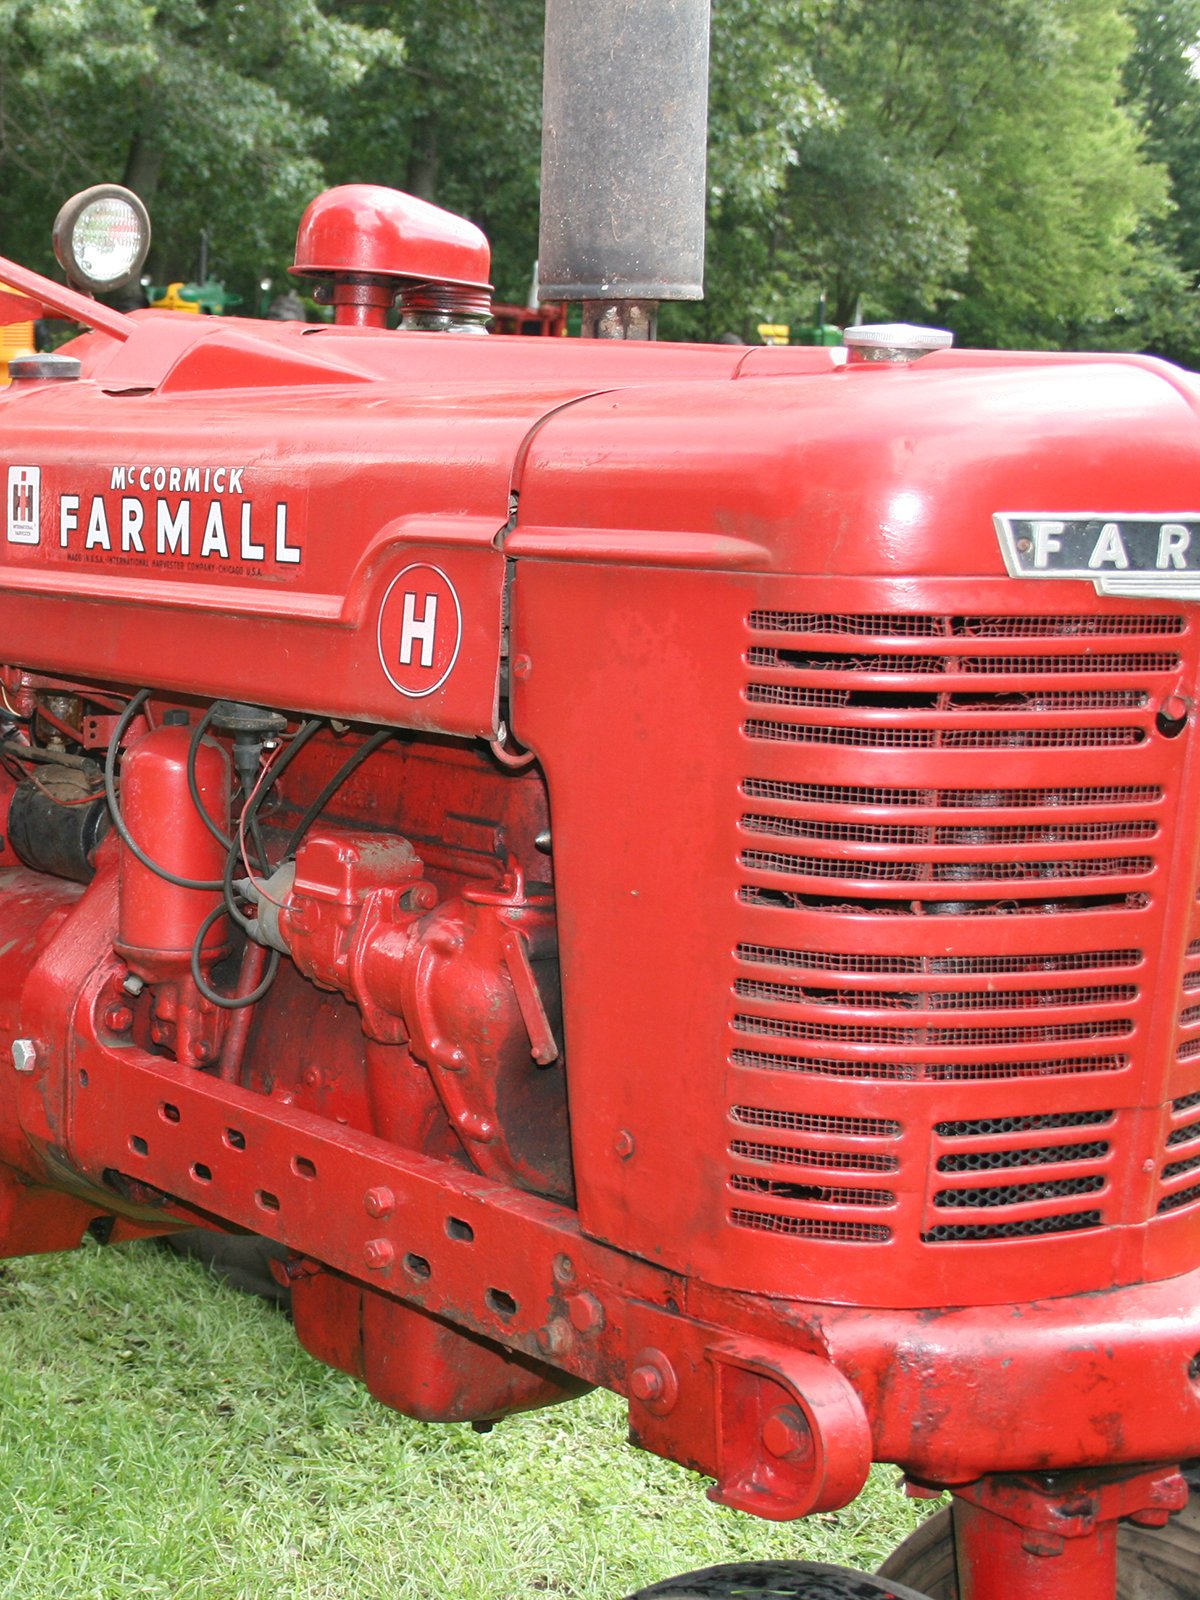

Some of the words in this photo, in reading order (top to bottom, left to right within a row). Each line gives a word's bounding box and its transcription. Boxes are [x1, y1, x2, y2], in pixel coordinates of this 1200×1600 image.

[60, 494, 301, 563] FARMALL
[152, 560, 184, 570] HARVESTER
[399, 591, 439, 669] H
